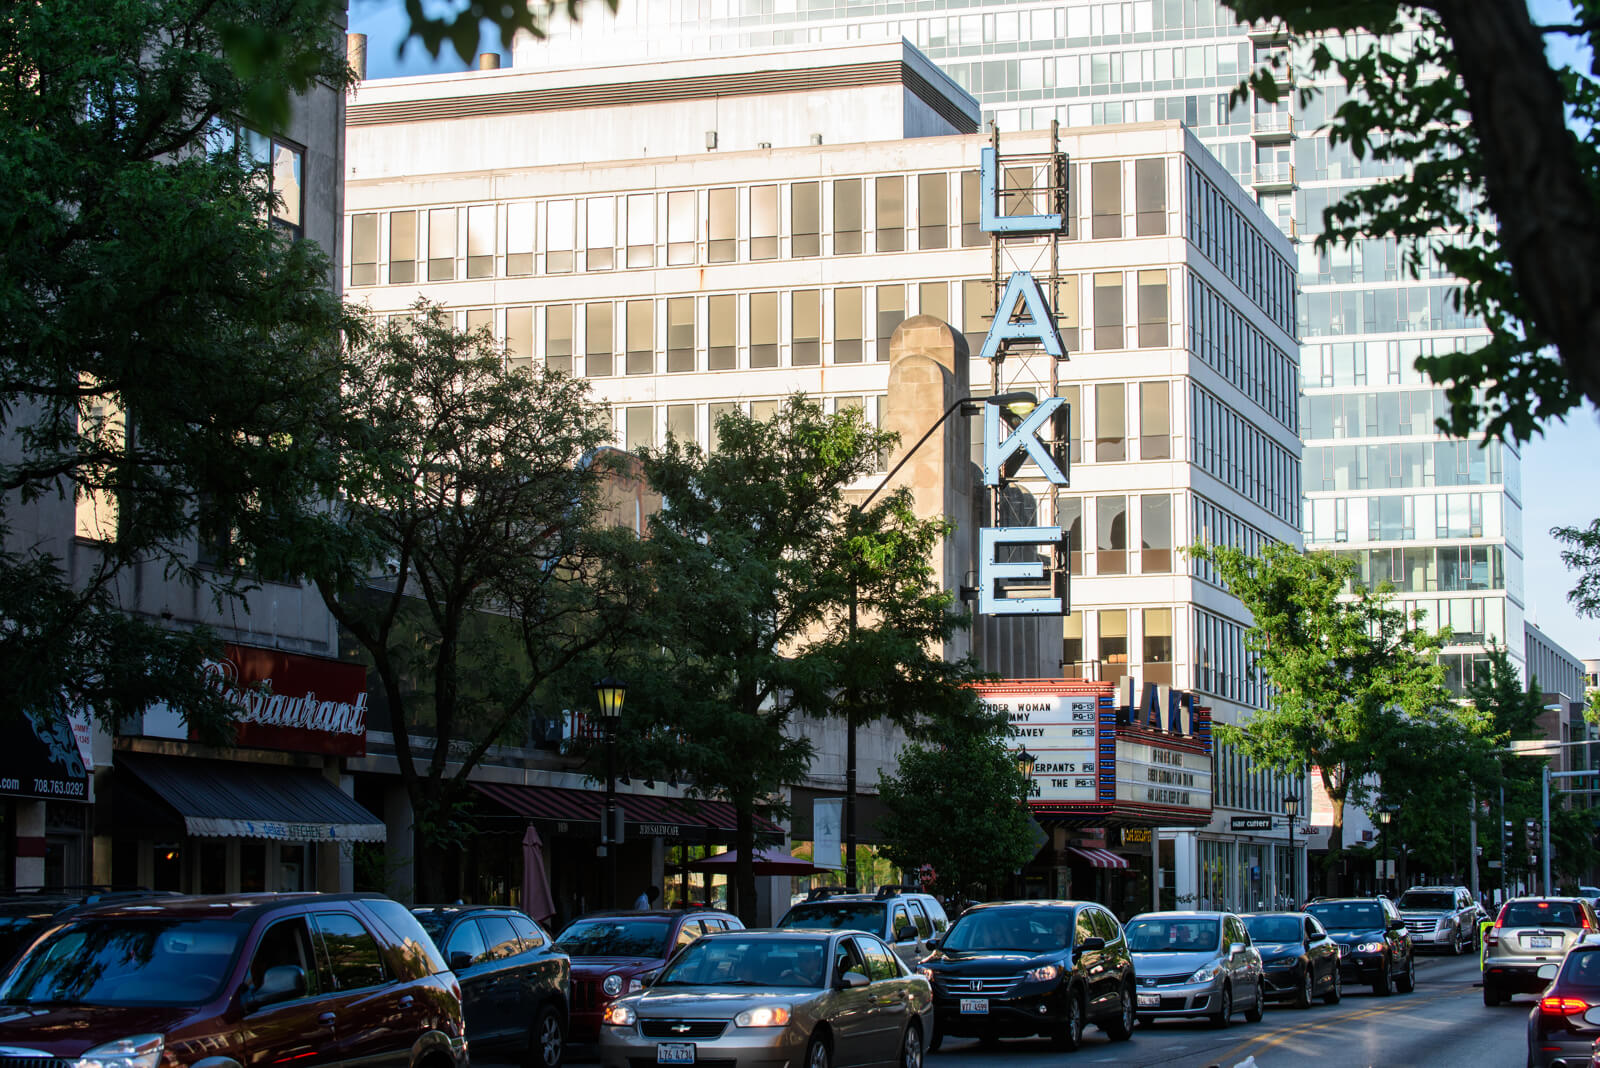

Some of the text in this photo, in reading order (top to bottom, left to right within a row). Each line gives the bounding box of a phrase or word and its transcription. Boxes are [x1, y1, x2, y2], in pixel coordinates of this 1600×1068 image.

[979, 146, 1069, 616] LAKE
[981, 703, 1009, 711] ONDER
[1017, 703, 1051, 711] WOMAN
[33, 778, 85, 796] 708.763.0292
[1051, 779, 1068, 787] THE
